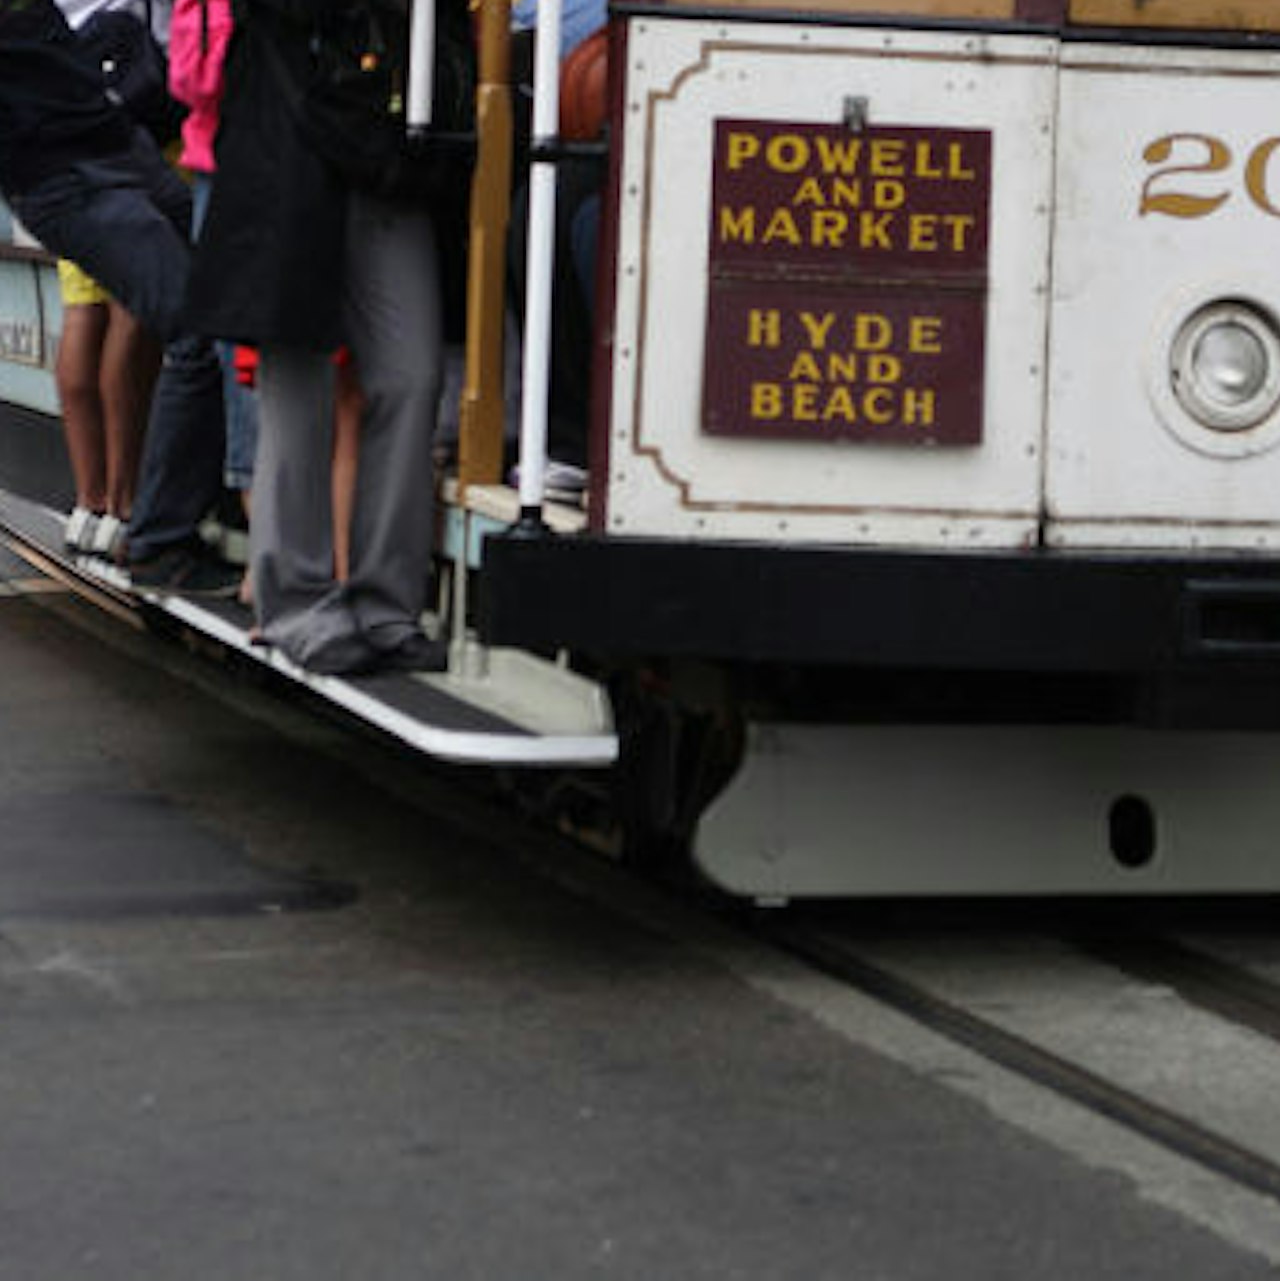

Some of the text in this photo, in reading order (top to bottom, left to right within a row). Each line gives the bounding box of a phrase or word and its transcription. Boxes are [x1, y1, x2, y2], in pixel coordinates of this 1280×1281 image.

[727, 132, 975, 181] POWELL
[792, 176, 907, 211] AND
[719, 205, 974, 252] MARKET
[747, 308, 942, 354] HYDE
[788, 351, 902, 384] AND
[750, 382, 936, 426] BEACH
